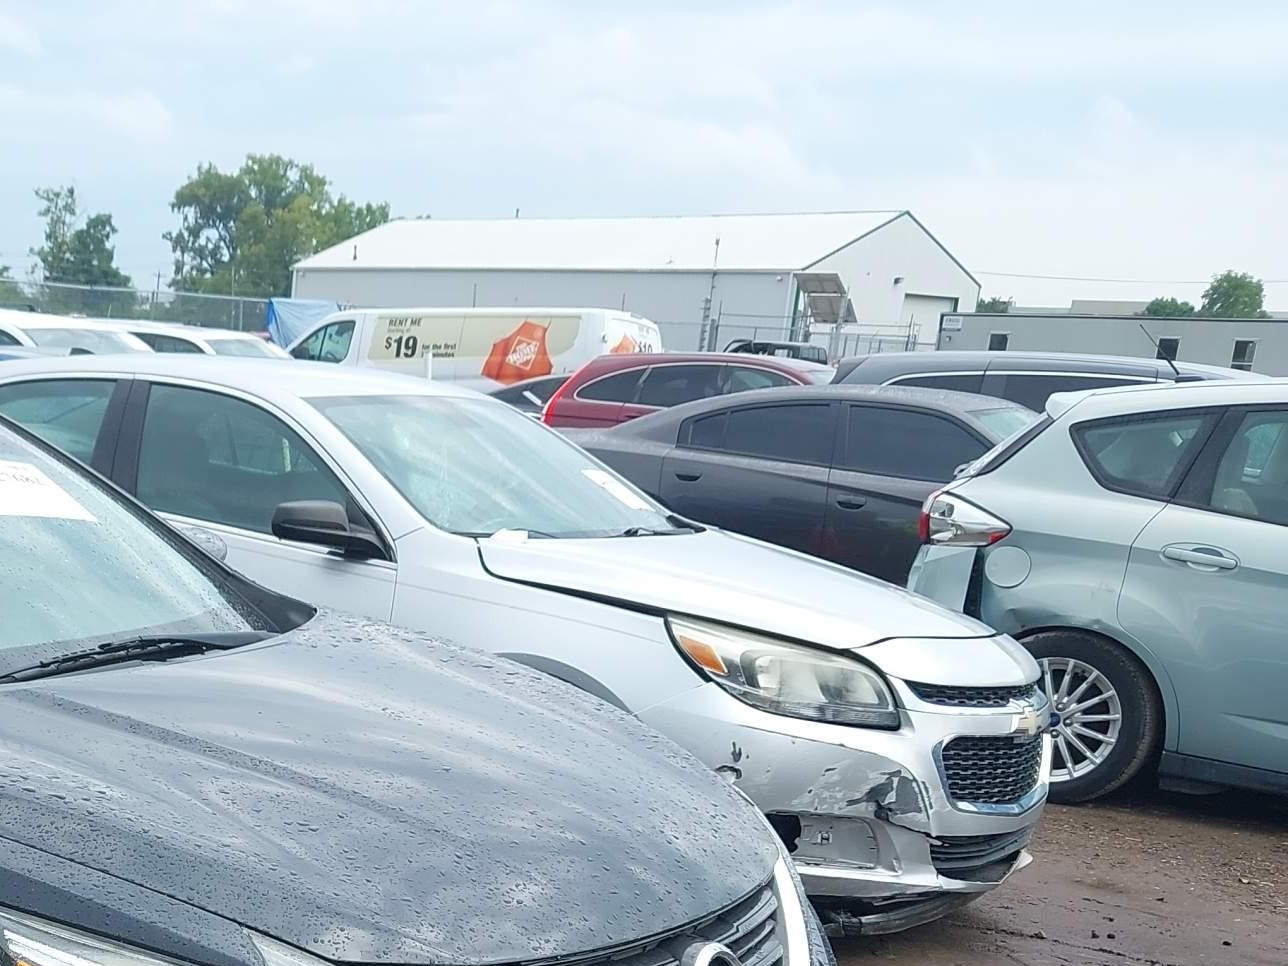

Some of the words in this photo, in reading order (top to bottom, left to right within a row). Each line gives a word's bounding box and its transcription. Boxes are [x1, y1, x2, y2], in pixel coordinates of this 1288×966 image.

[388, 318, 407, 327] RENT
[409, 317, 422, 327] ME
[384, 335, 418, 358] $19
